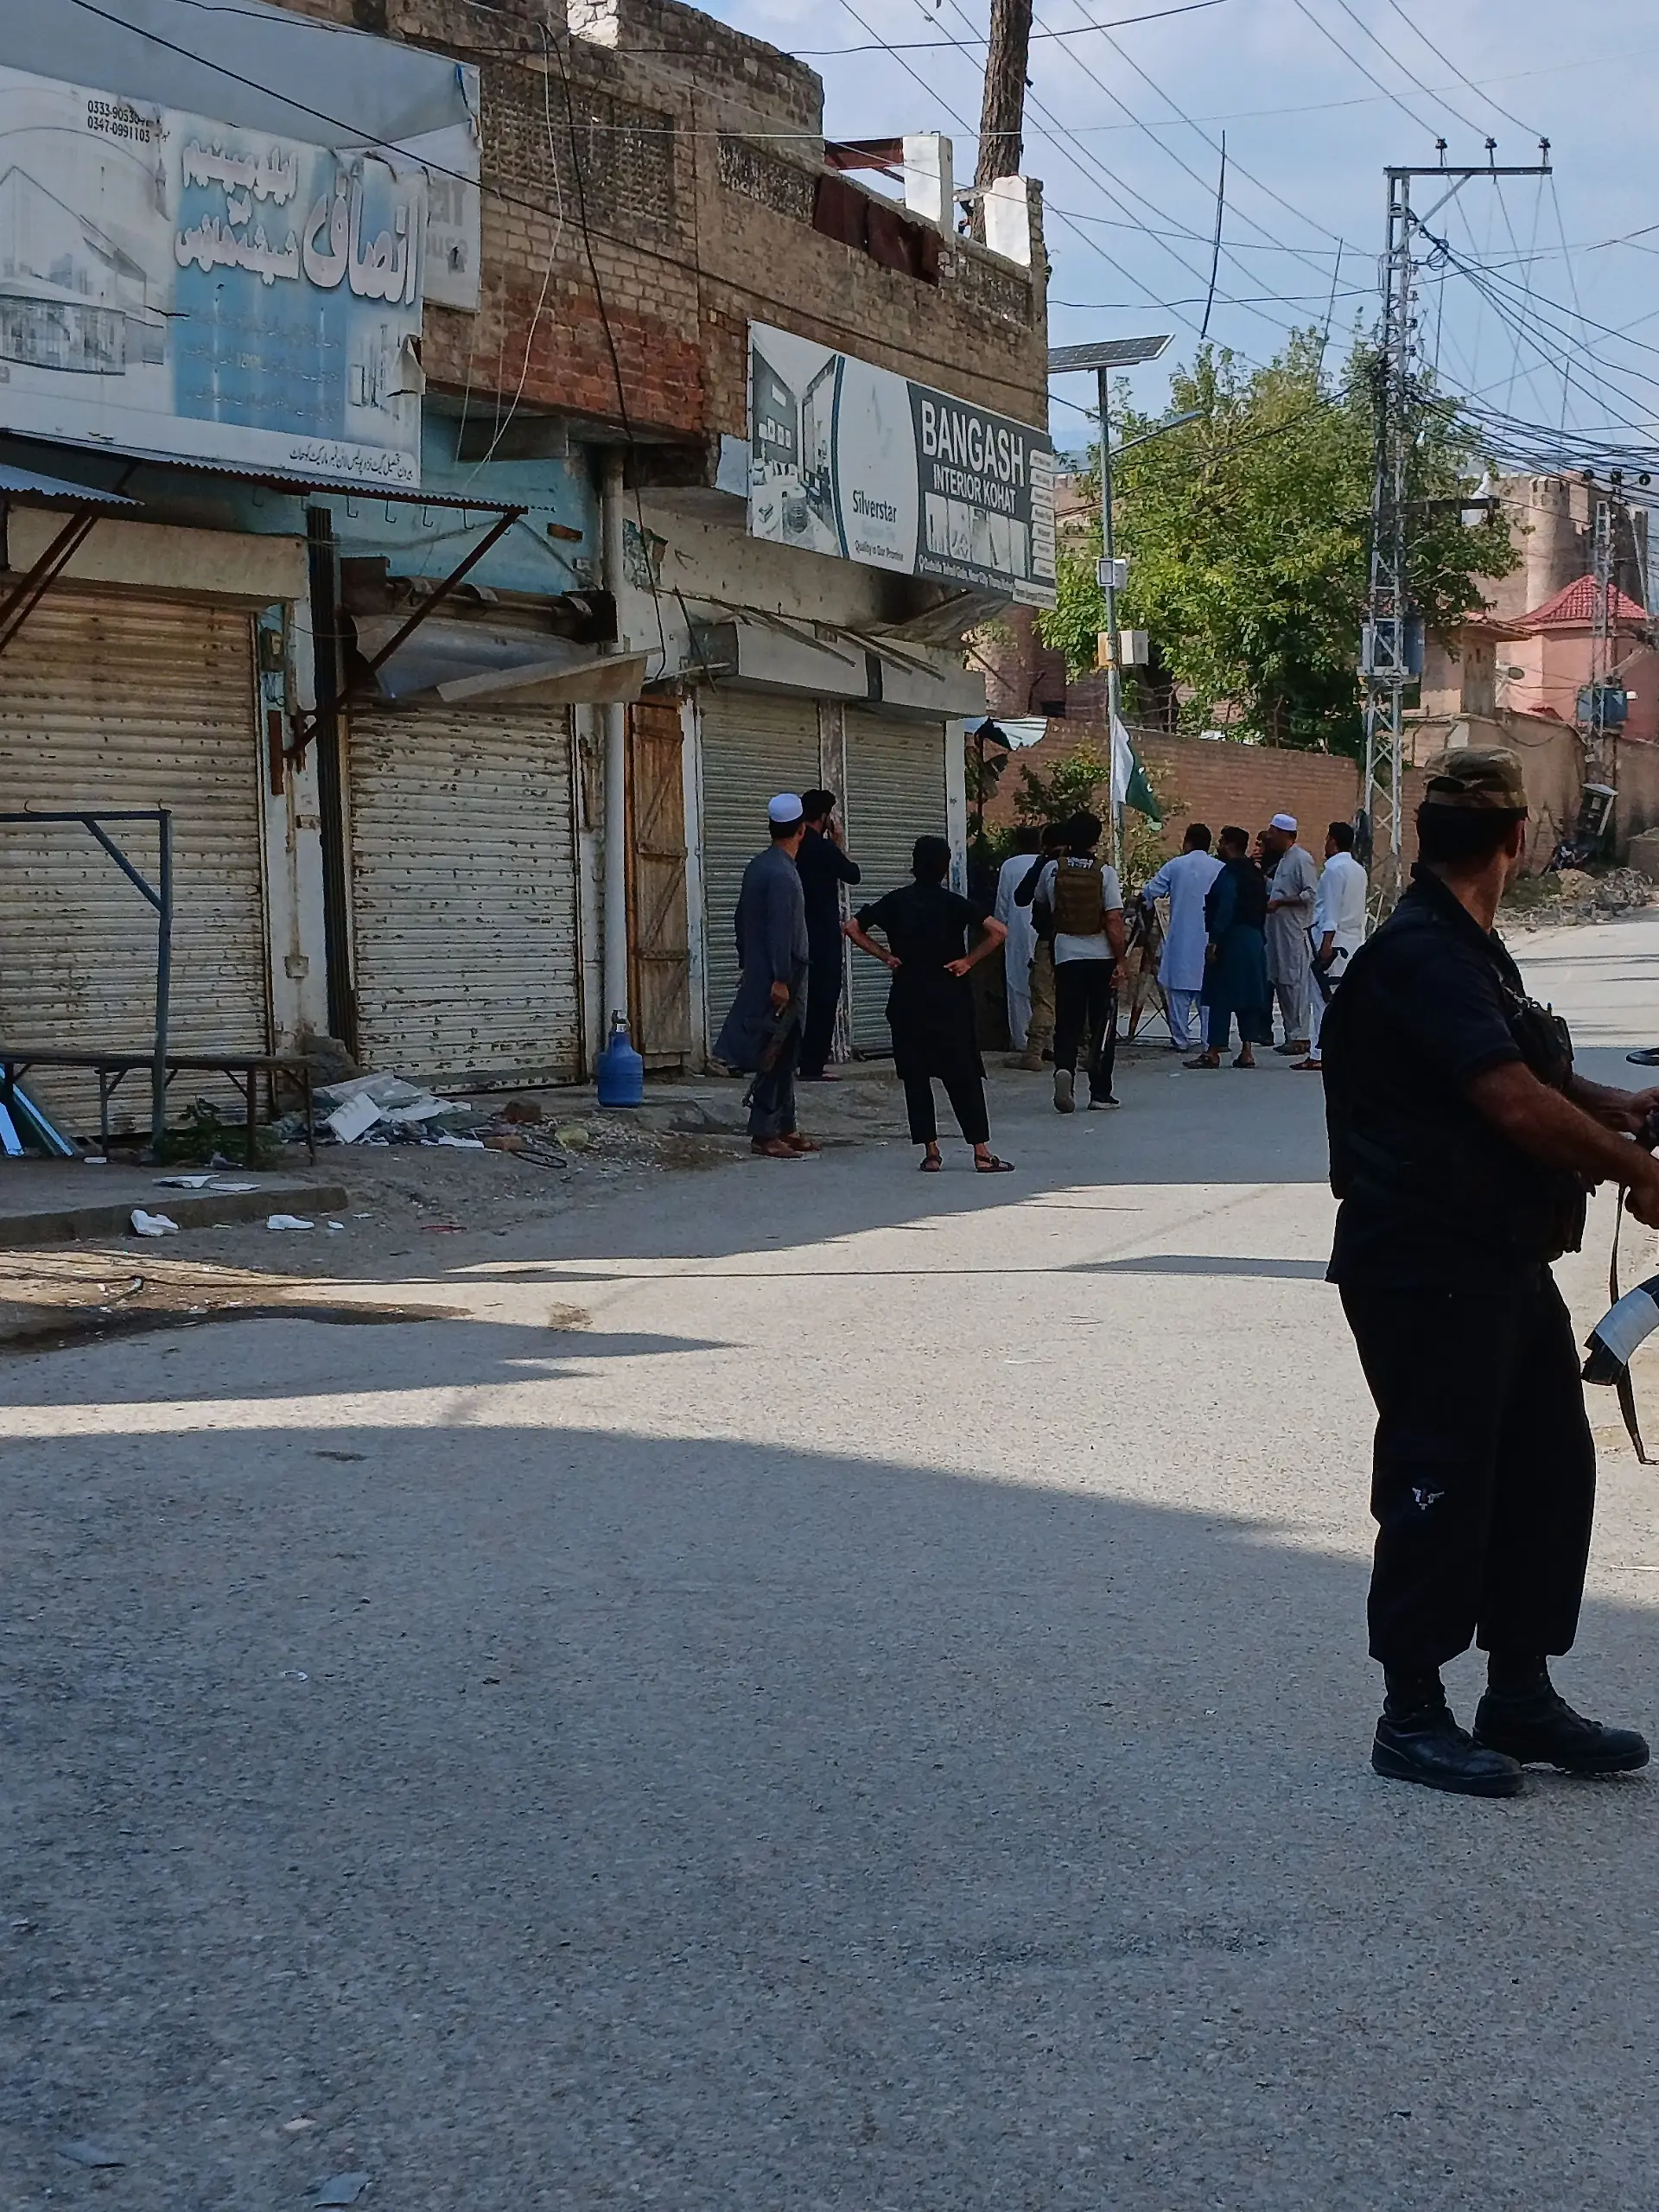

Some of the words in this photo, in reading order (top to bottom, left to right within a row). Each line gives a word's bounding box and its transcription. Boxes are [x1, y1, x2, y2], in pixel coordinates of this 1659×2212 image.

[303, 167, 420, 305] انصاف
[922, 399, 1025, 487] BANGASH
[853, 489, 897, 524] Silverstar
[933, 463, 982, 503] INTERIOR
[983, 480, 1016, 514] KOHAT
